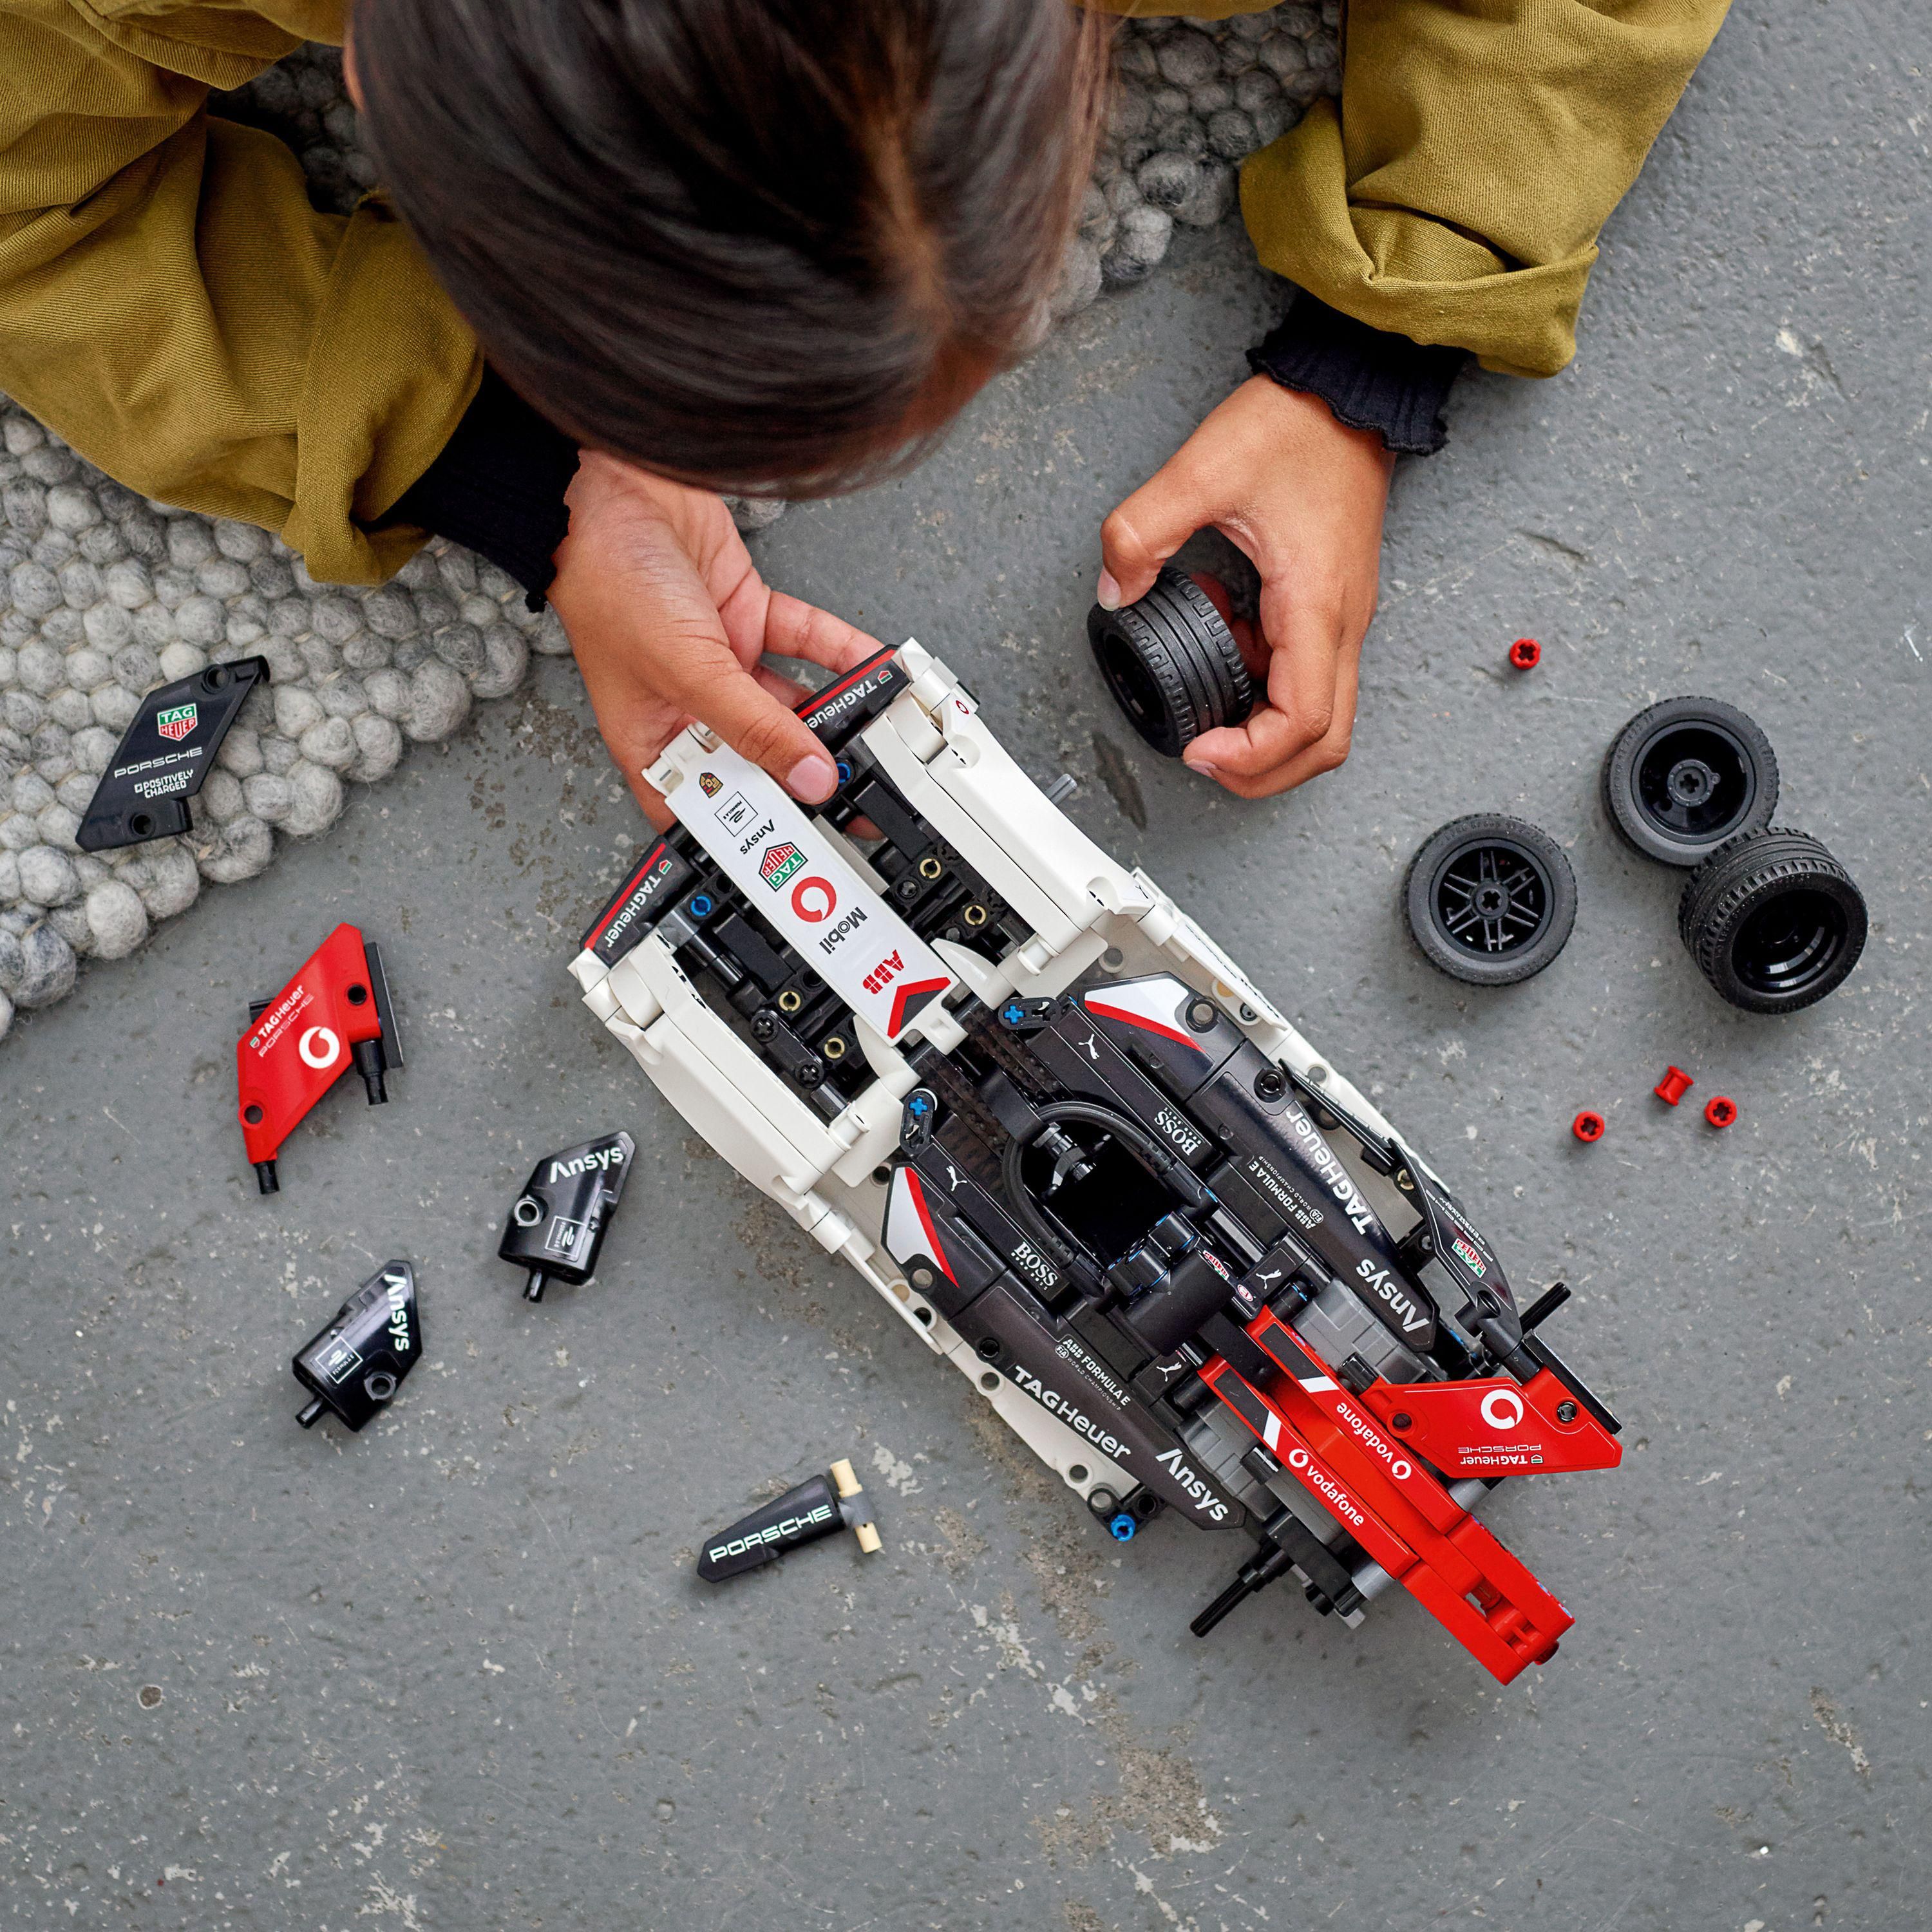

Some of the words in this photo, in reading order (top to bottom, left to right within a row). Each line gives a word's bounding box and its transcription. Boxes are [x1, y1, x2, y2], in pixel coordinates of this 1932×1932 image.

[162, 707, 193, 724] TAG
[162, 719, 196, 739] HEUER
[114, 746, 203, 779] PORSCHE
[143, 769, 193, 790] POSITIVELY
[144, 780, 187, 799] CHARGED
[740, 819, 775, 855] Ansys
[763, 846, 793, 876] HEUER
[771, 857, 802, 884] TAG
[819, 907, 867, 954] Mobil
[862, 949, 905, 995] ABB
[259, 994, 314, 1057] PORSCHE
[1154, 1110, 1198, 1156] BOSS
[550, 1147, 624, 1184] Ansys
[1249, 1160, 1260, 1171] E
[1258, 1156, 1294, 1193] CHAMPIONSHIP
[1256, 1167, 1298, 1212] FORMULA
[1294, 1192, 1311, 1211] WORLD
[1295, 1209, 1316, 1229] ABB
[1014, 1242, 1058, 1287] BOSS
[384, 1274, 410, 1352] Ansys
[1356, 1259, 1430, 1332] Ansys
[1063, 1339, 1084, 1358] ABB
[1081, 1356, 1122, 1399] FORMULA
[1121, 1396, 1131, 1406] E
[1068, 1358, 1085, 1375] WORLD
[1085, 1375, 1121, 1411] CHAMPIONSHIP
[1336, 1402, 1393, 1463] vodafone
[1457, 1444, 1542, 1454] PORSCHE
[1155, 1448, 1228, 1521] Ansys
[1307, 1465, 1364, 1526] vodafone
[709, 1504, 833, 1563] PORSCHE
